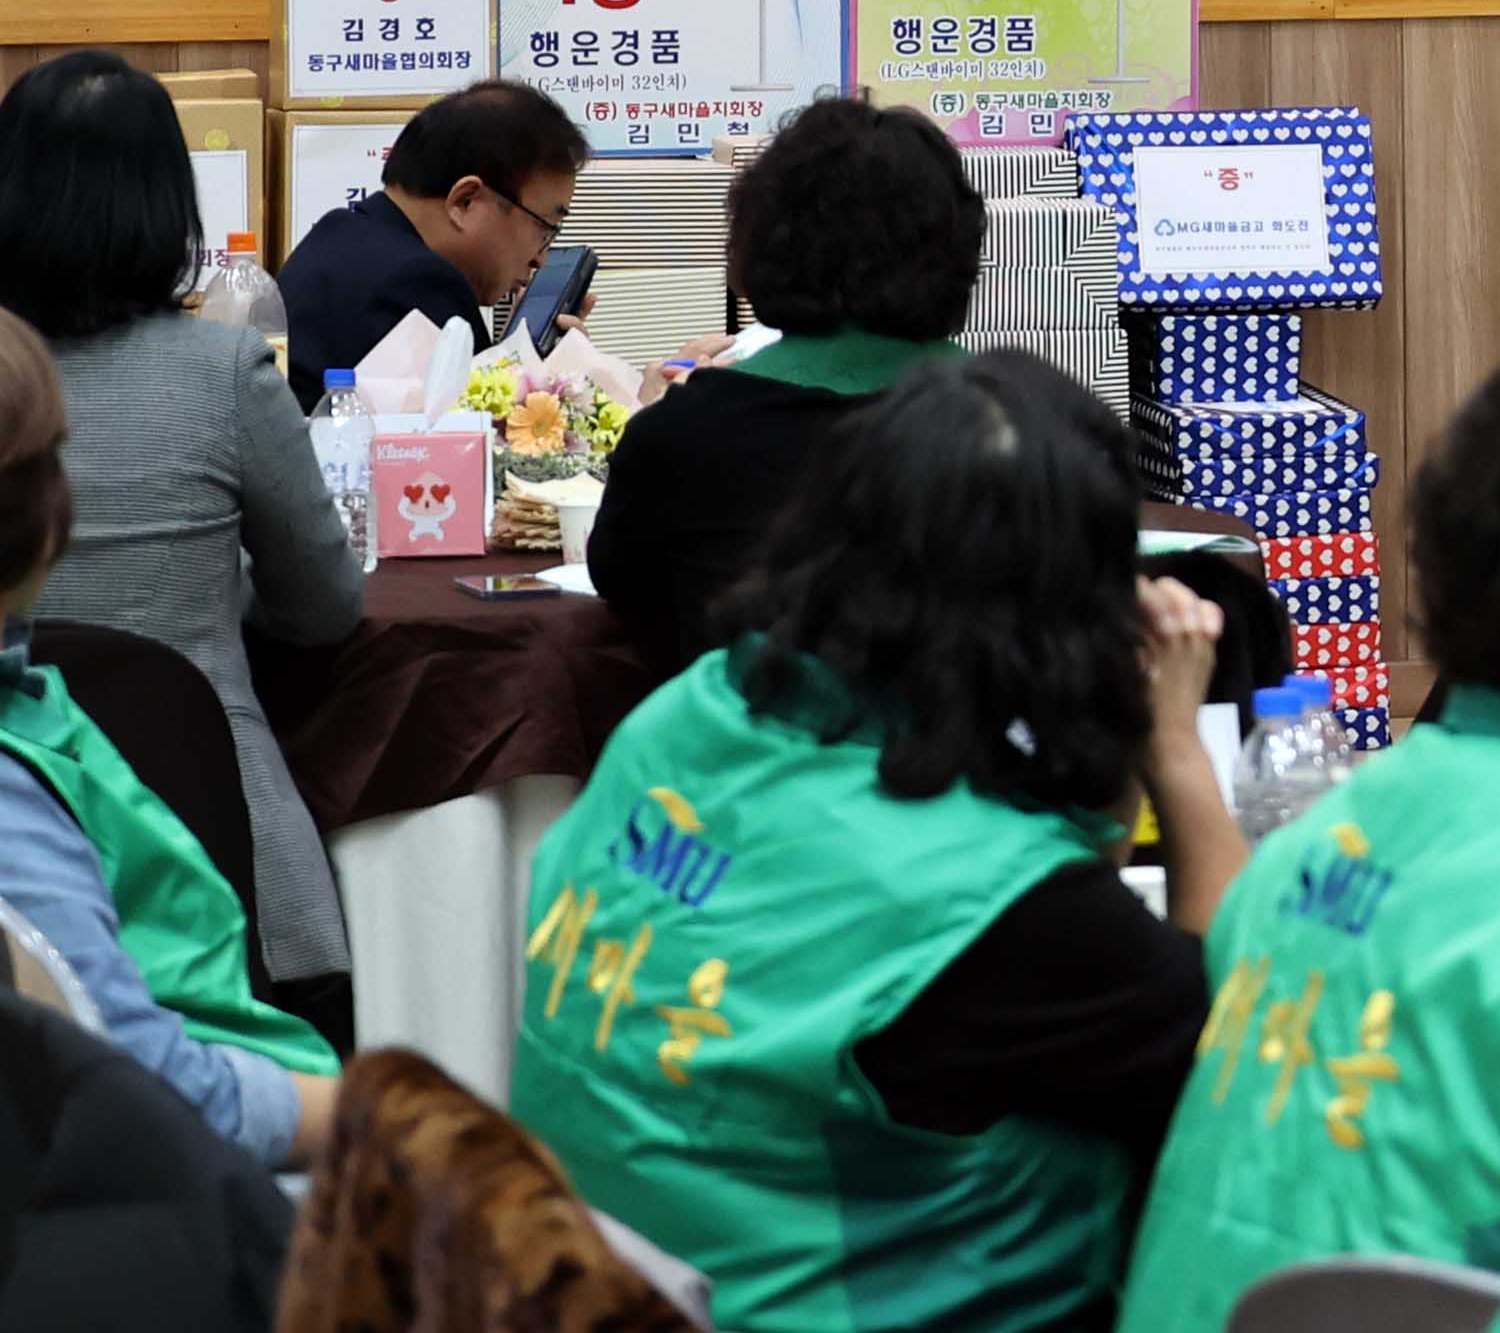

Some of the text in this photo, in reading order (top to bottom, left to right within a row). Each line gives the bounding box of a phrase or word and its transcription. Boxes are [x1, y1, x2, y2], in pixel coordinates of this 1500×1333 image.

[307, 49, 472, 72] 동구새마을협의회장
[990, 59, 1045, 79] 32인치)
[631, 72, 688, 91] 32인치)
[625, 100, 763, 119] 동구새마을지회장
[976, 91, 1111, 111] 동구새마을지회장
